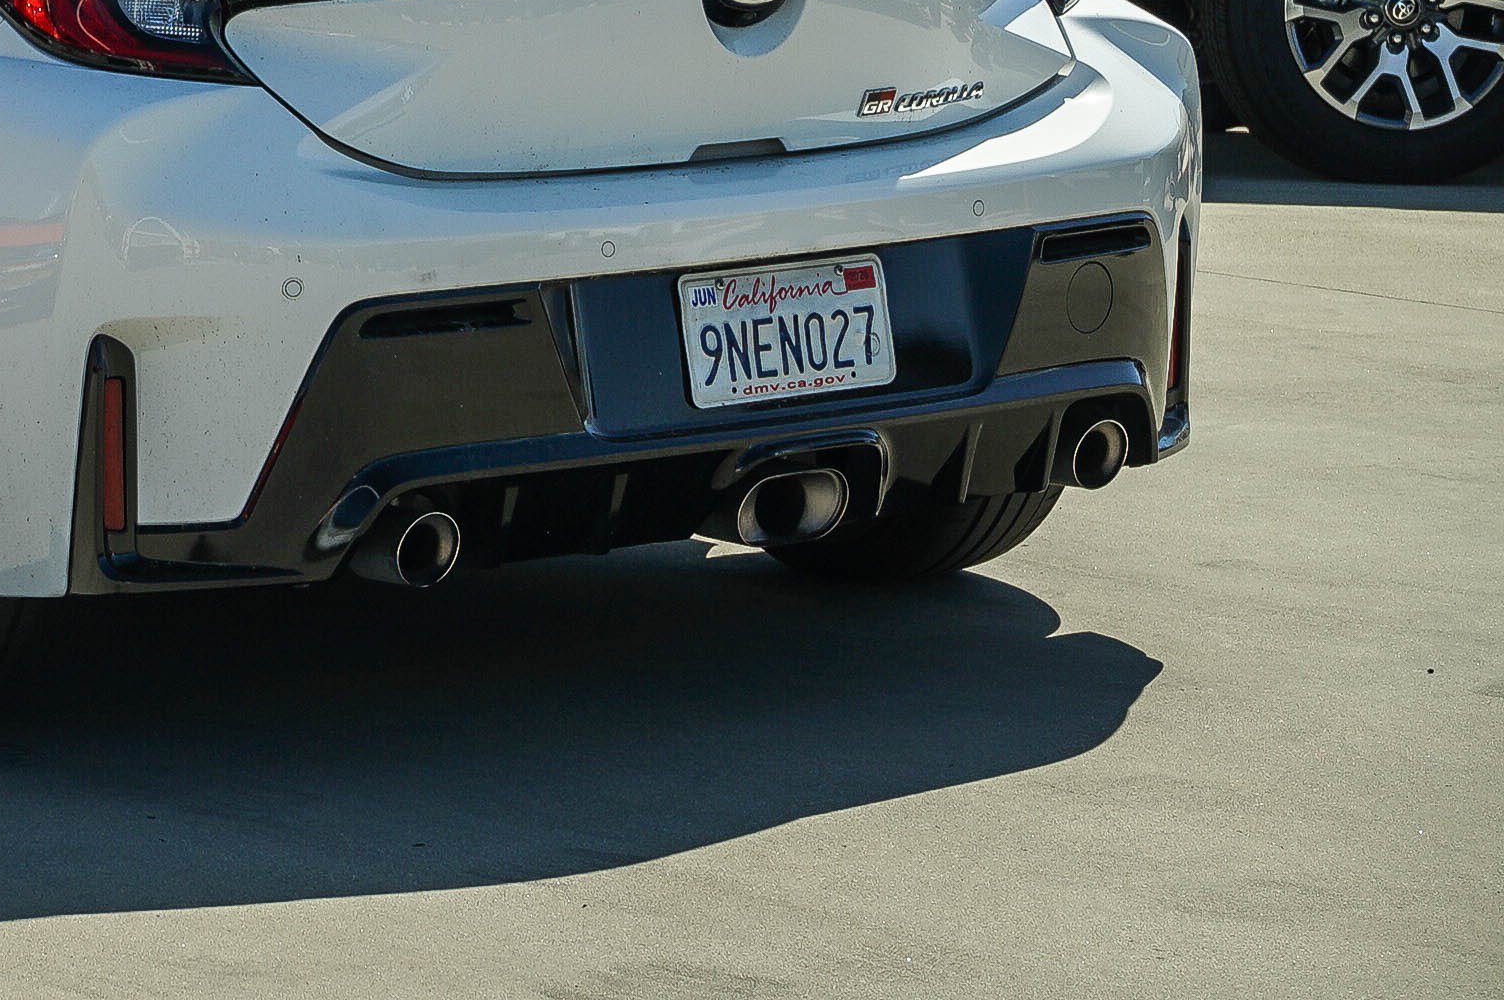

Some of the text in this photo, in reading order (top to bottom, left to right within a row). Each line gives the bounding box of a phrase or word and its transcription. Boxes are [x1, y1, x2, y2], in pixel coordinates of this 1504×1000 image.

[863, 81, 984, 115] GR COROLLA
[691, 272, 848, 314] JUN California
[699, 304, 875, 387] 9NEN027
[742, 373, 846, 396] dmv.ca.gov
